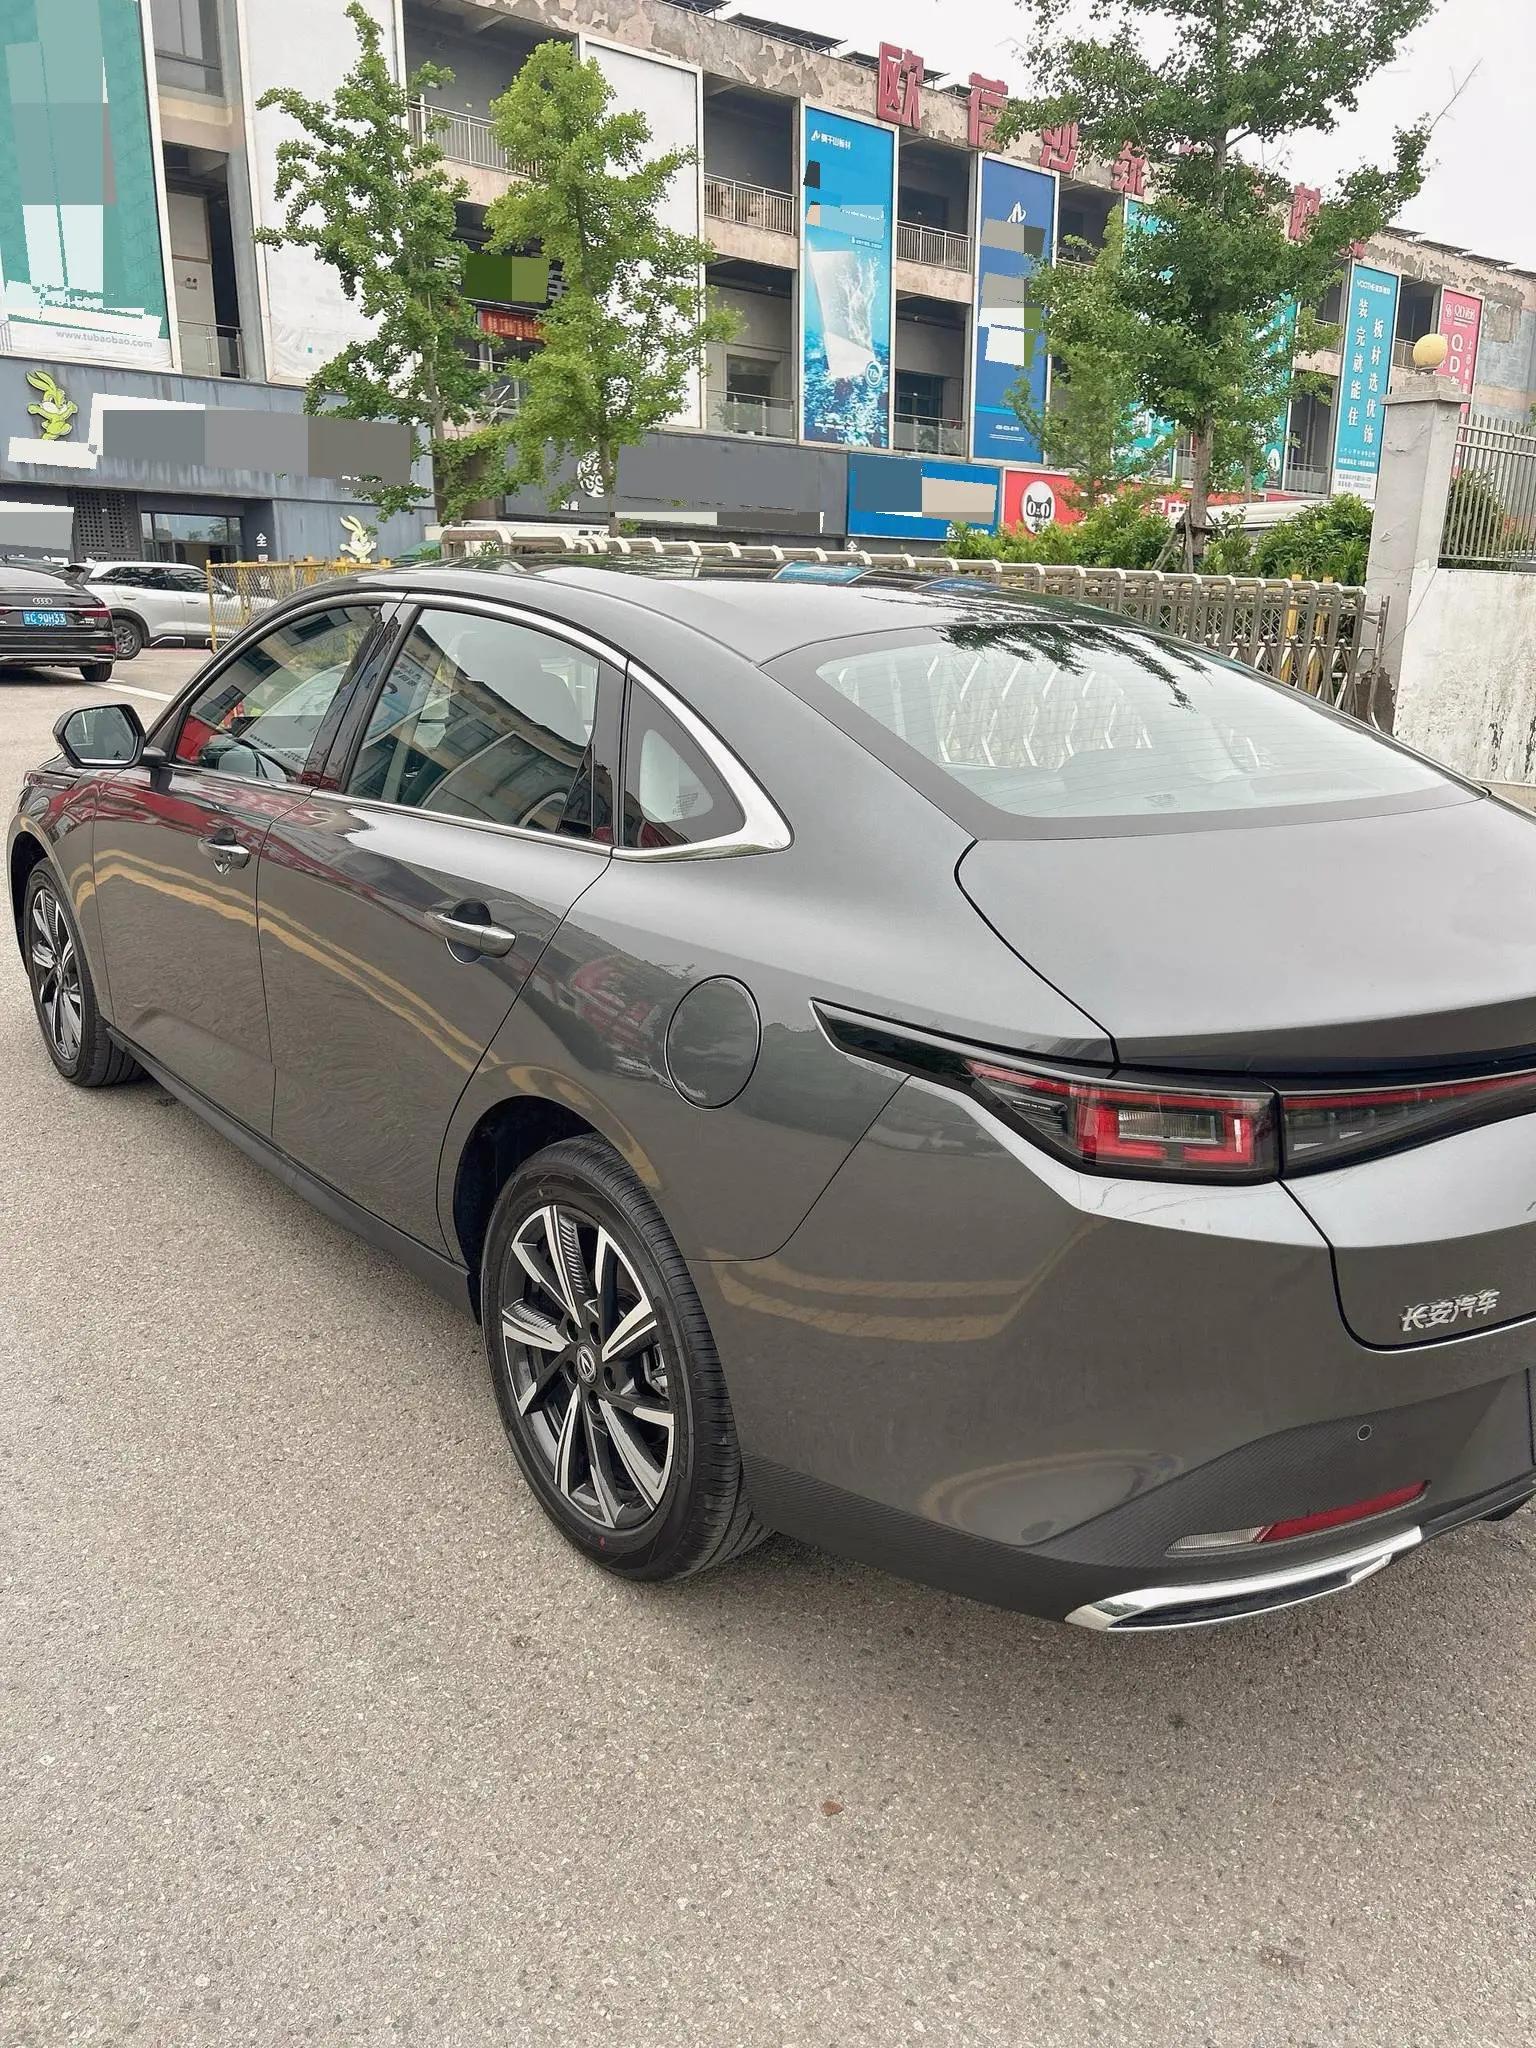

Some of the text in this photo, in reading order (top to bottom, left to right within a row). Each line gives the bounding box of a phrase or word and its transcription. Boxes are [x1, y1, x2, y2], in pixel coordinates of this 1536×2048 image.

[56, 330, 153, 349] www.tubaobao.com
[1346, 297, 1369, 427] 装完就能住
[1363, 317, 1385, 445] 板材选优饰
[1400, 1288, 1501, 1332] 长安汽车
